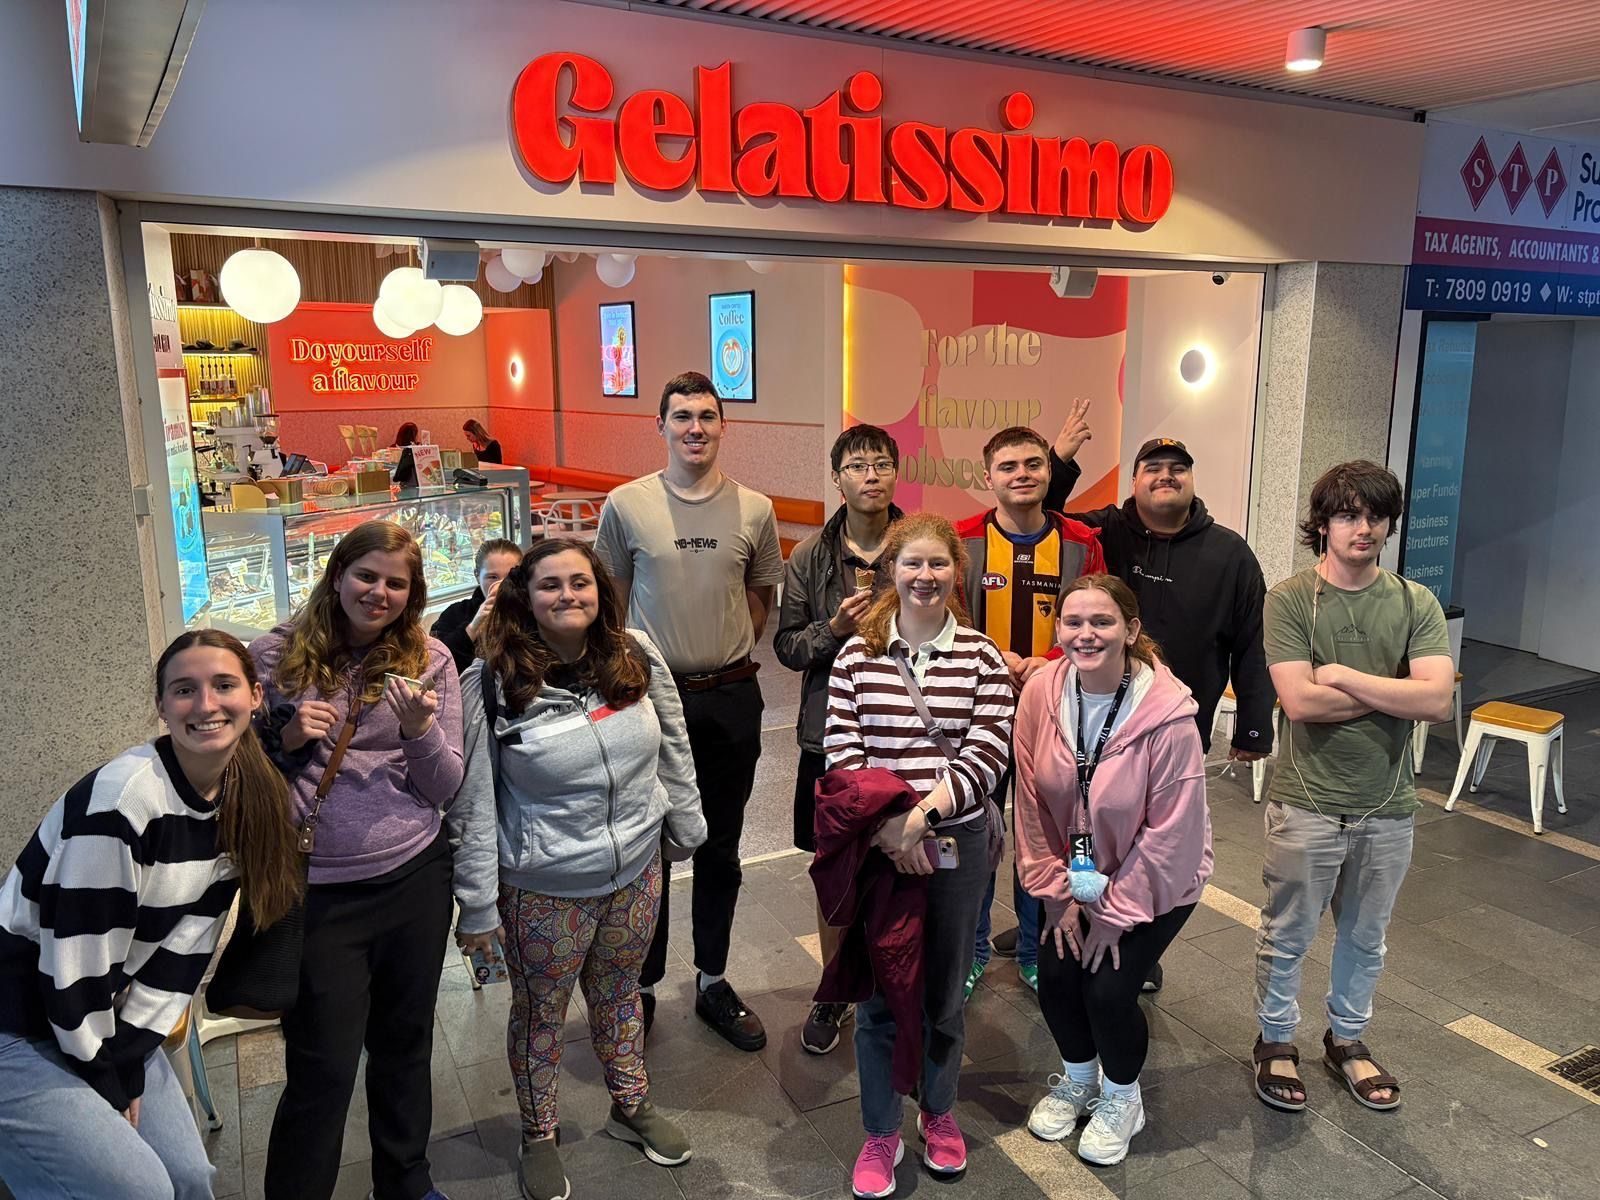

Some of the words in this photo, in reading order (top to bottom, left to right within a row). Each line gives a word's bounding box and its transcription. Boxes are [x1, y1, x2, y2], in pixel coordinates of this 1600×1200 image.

[511, 51, 1174, 225] Gelatissimo
[1425, 231, 1448, 253] TAX
[1451, 234, 1502, 261] AGENTS,
[1508, 239, 1589, 264] ACCOUNTANTS
[1591, 246, 1599, 264] &
[1426, 279, 1440, 298] T:
[1446, 278, 1487, 301] 7809
[1491, 281, 1531, 303] 0919
[1557, 285, 1573, 303] W:
[719, 309, 745, 326] Coffee
[289, 338, 326, 361] Do
[328, 338, 433, 367] yourself
[919, 329, 979, 367] For
[984, 321, 1042, 367] the
[312, 373, 329, 391] a
[333, 366, 419, 391] flavour
[918, 383, 1042, 430] flavour
[415, 448, 431, 457] NEW
[1432, 483, 1459, 497] Funds
[1409, 515, 1449, 529] Business
[1406, 535, 1449, 551] Structures
[981, 576, 1004, 586] AFL
[1405, 564, 1444, 579] Business
[1074, 837, 1085, 866] VIP
